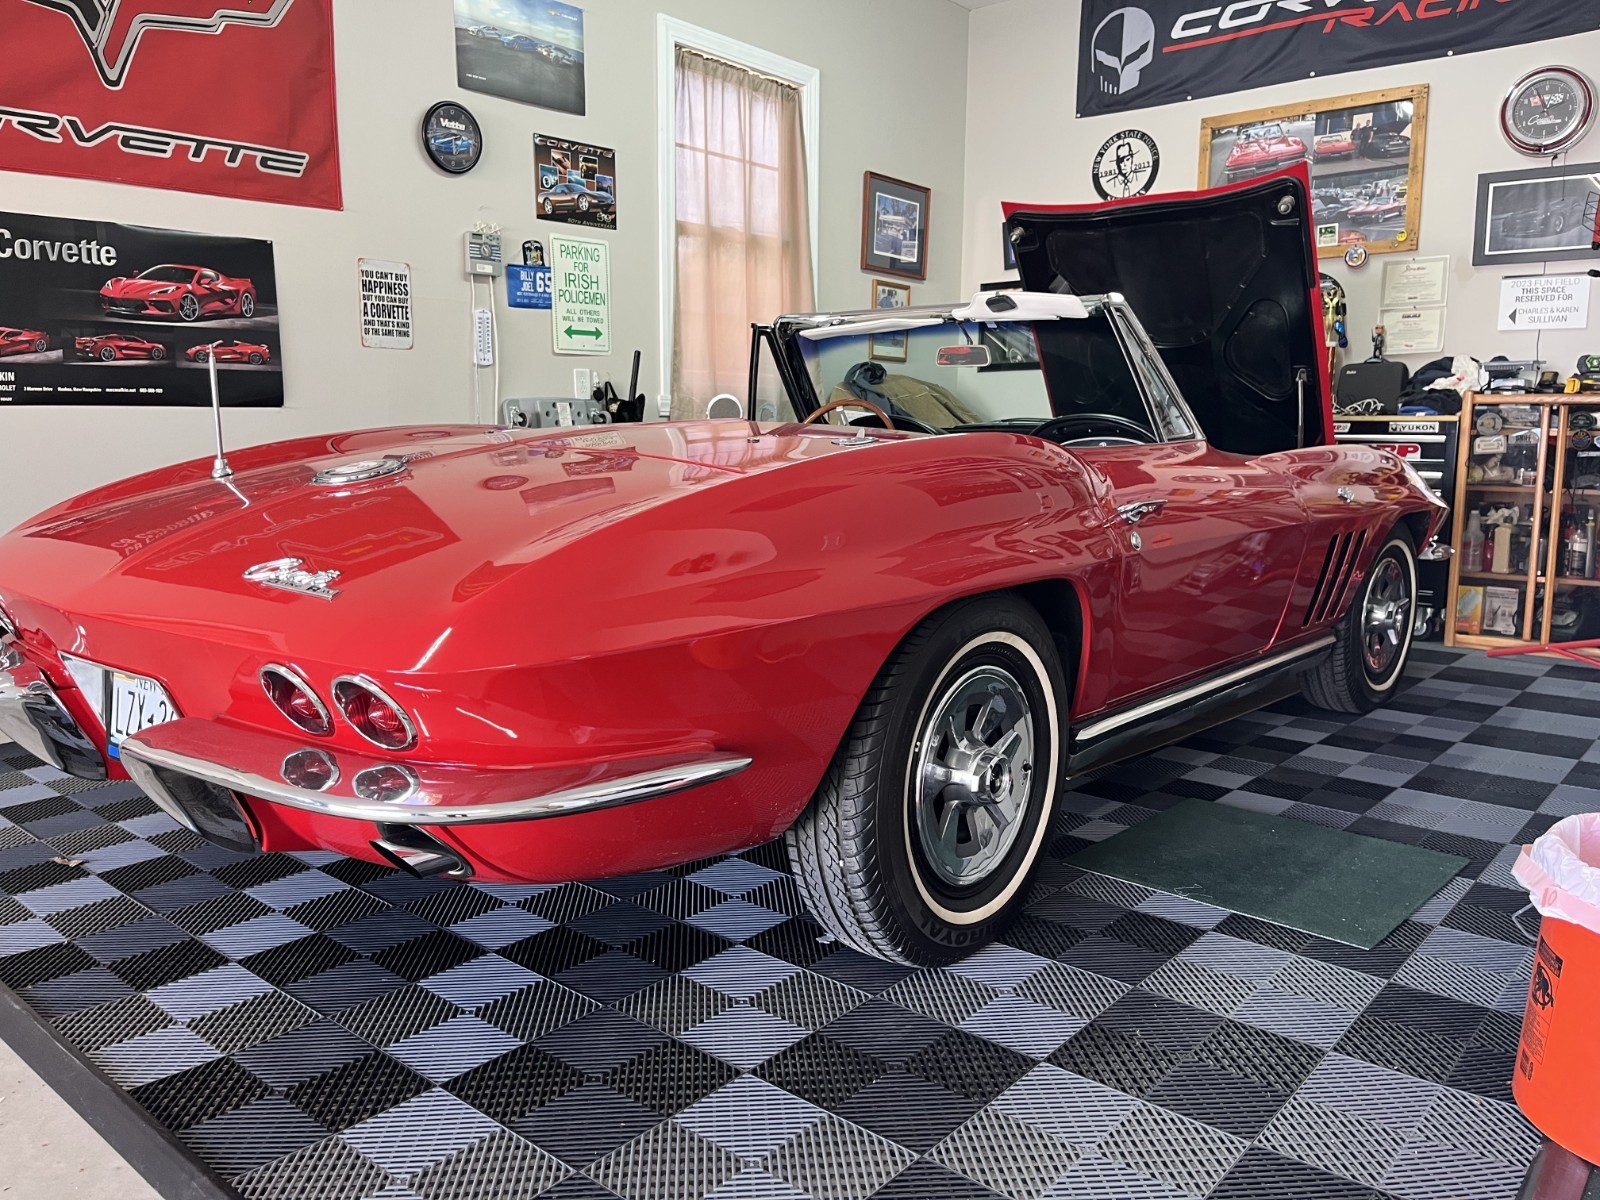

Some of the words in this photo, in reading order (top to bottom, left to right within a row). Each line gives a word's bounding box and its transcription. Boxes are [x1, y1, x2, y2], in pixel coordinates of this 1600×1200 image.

[0, 106, 308, 176] RVETTE
[535, 136, 614, 158] CORVETTE
[1093, 156, 1102, 173] NEW
[1100, 135, 1119, 154] YORK
[1120, 130, 1142, 139] STATE
[1142, 135, 1159, 161] POLICE
[582, 220, 616, 229] ANNIVERSARY
[560, 244, 600, 262] PARKING
[573, 262, 589, 273] FOR
[360, 269, 374, 279] YOU
[375, 271, 393, 280] CAN'T
[395, 273, 407, 282] BUY
[520, 270, 534, 281] BILLY
[564, 272, 599, 290] IRISH
[361, 279, 409, 296] HAPPINESS
[521, 281, 534, 292] JOEL
[536, 272, 552, 293] 65
[1511, 279, 1532, 288] 2023
[1534, 279, 1553, 287] FUN
[1555, 277, 1580, 286] FIELD
[1521, 287, 1539, 295] THIS
[1541, 286, 1566, 294] SPACE
[362, 293, 373, 301] BUT
[374, 295, 385, 303] YOU
[386, 296, 397, 304] CAN
[398, 297, 408, 305] BUY
[558, 289, 606, 306] POLICEMEN
[1515, 294, 1555, 303] RESERVED
[1557, 293, 1573, 301] FOR
[363, 302, 369, 317] A
[370, 302, 409, 320] CORVETTE
[579, 309, 600, 317] OTHERS
[1518, 307, 1549, 315] CHARLES
[363, 319, 375, 327] AND
[377, 319, 395, 328] THAT'S
[396, 321, 409, 329] KIND
[586, 316, 604, 324] TOWED
[1528, 315, 1568, 324] SULLIVAN
[363, 327, 371, 336] OF
[371, 328, 380, 337] THE
[381, 328, 395, 337] SAME
[395, 329, 410, 338] THING
